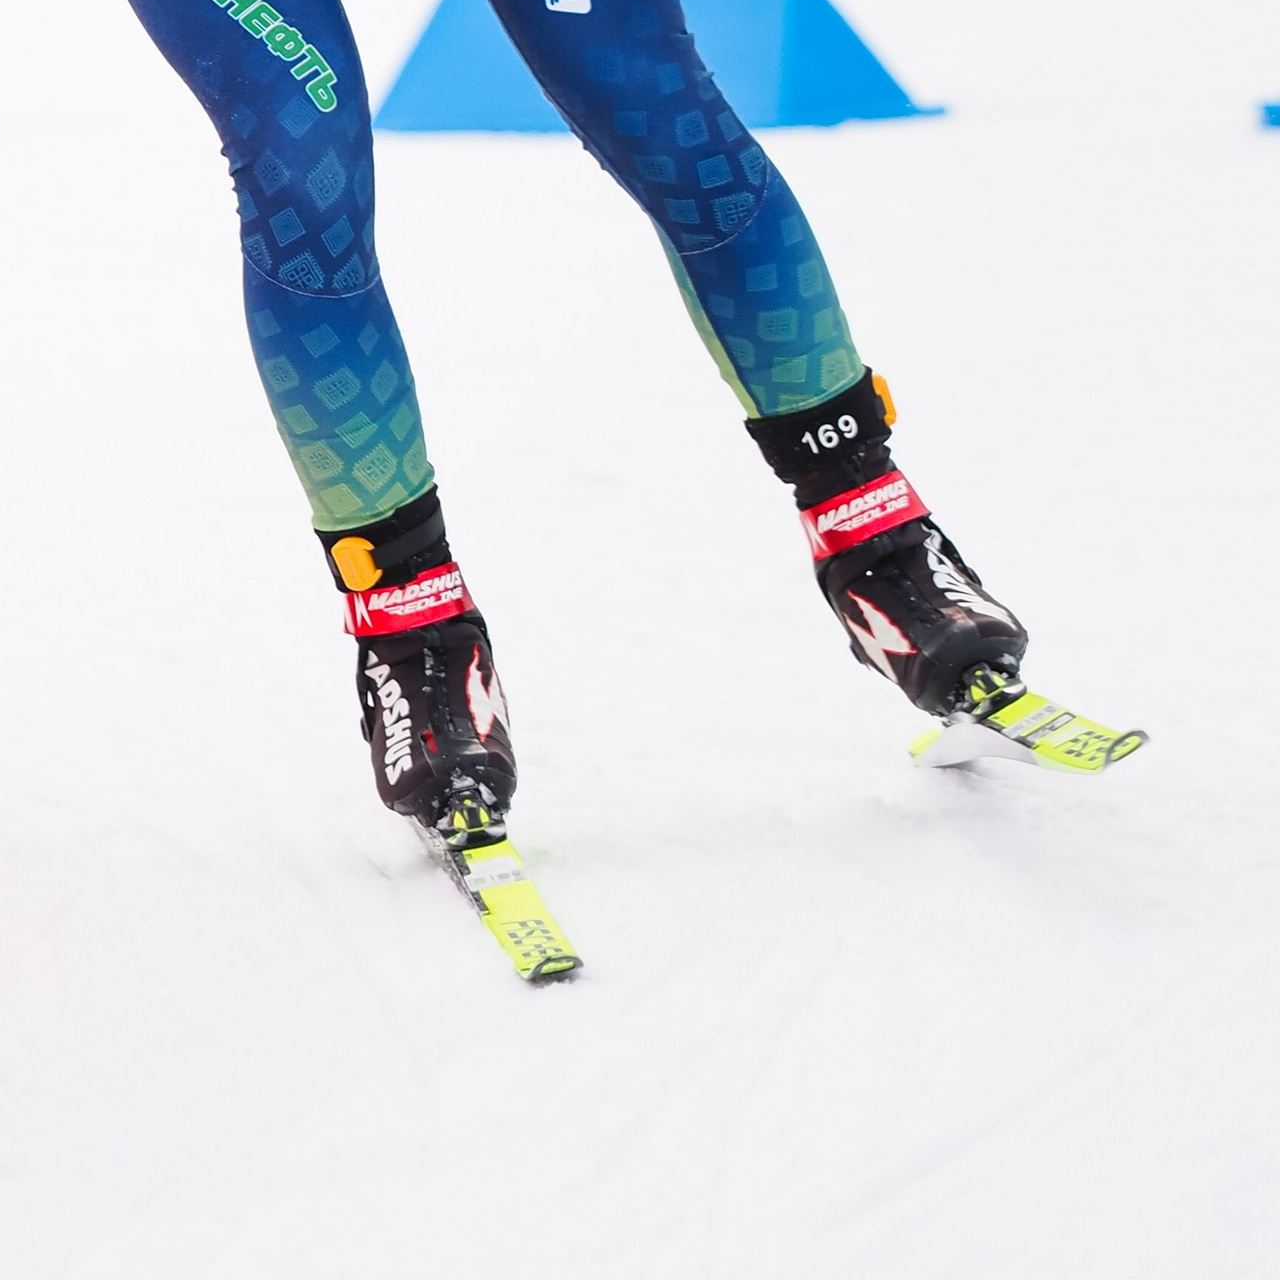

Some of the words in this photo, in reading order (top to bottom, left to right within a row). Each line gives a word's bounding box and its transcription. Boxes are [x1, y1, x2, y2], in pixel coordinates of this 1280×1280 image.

[801, 414, 859, 454] 169
[817, 479, 909, 534] MADSHUS
[831, 495, 911, 531] REDLINE
[368, 570, 462, 611] MADSHUS
[383, 587, 464, 616] REDLINE
